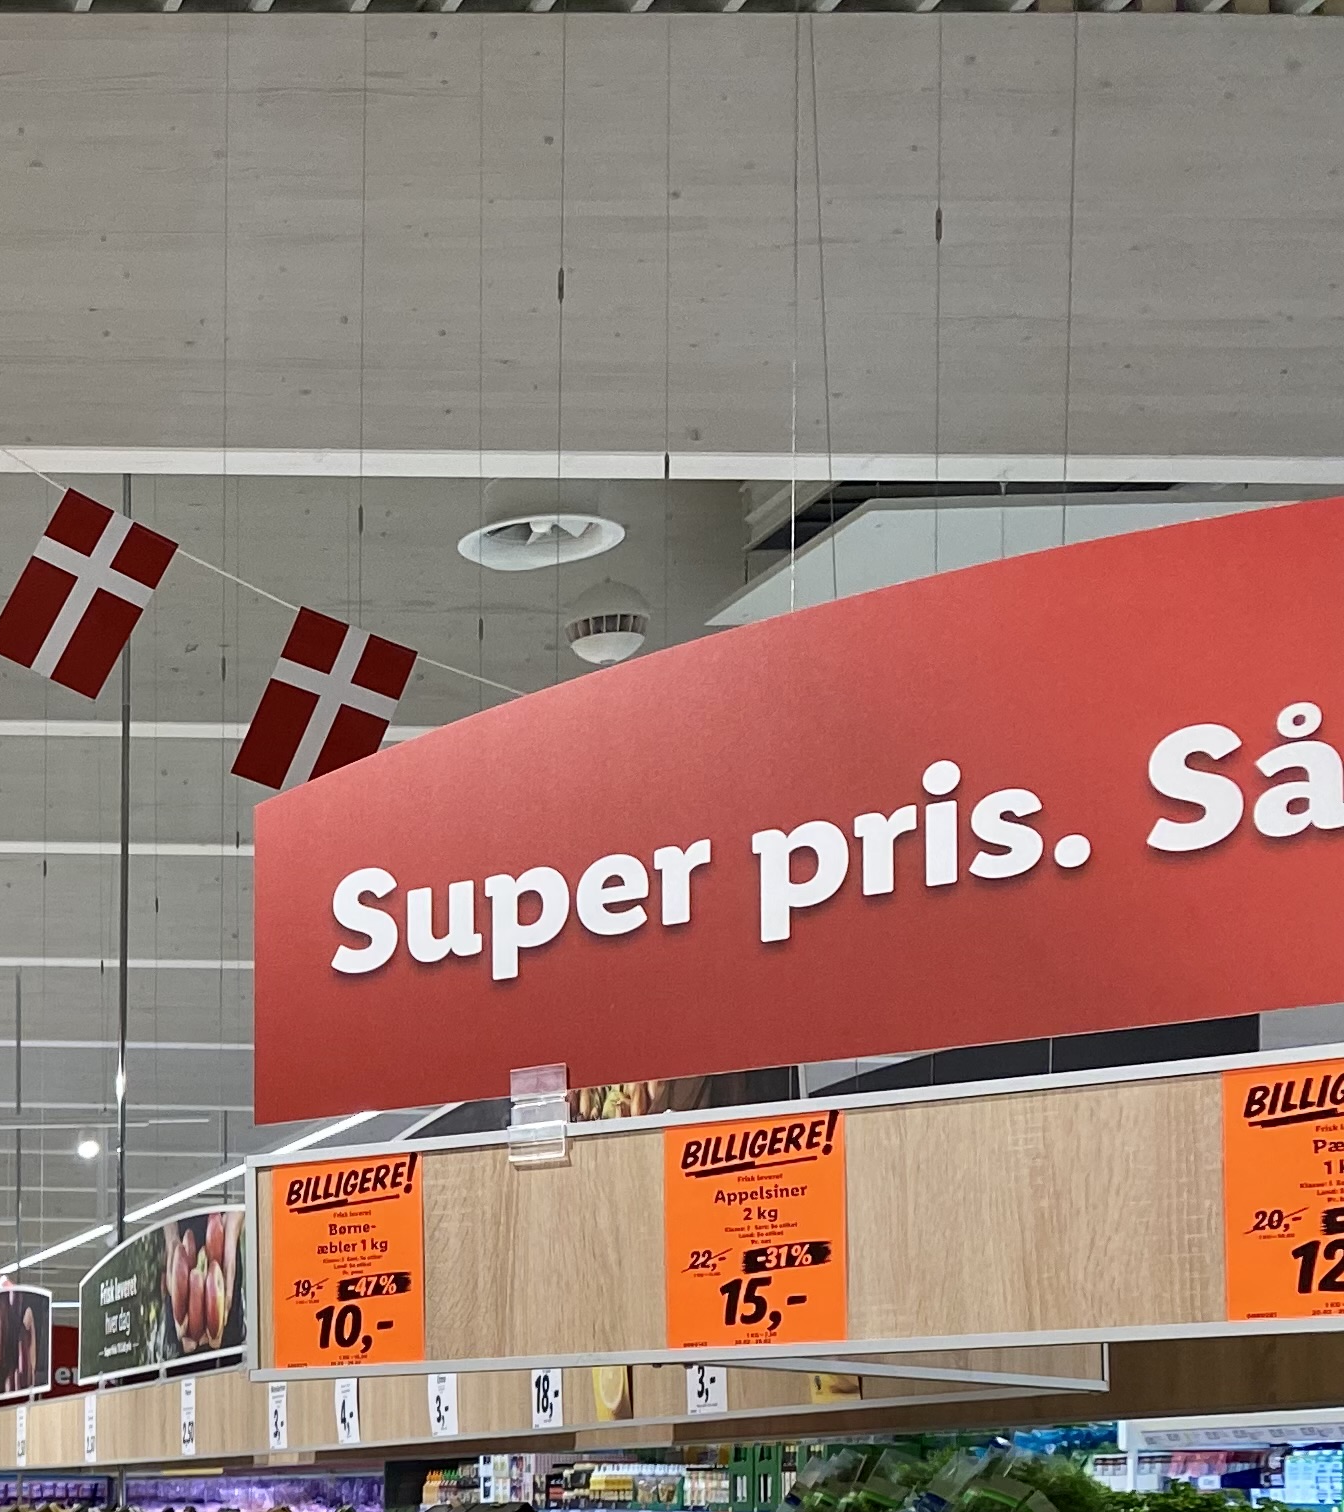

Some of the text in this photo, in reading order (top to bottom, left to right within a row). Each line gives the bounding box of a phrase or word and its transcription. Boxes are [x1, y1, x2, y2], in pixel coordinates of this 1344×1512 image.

[331, 702, 1344, 980] Super pris. Så
[681, 1110, 839, 1169] BILLIGERE!
[286, 1152, 418, 1206] BILLIGERE!
[714, 1184, 807, 1206] Appelsiner
[328, 1223, 376, 1236] Børne-
[743, 1206, 778, 1222] 2 kg
[1253, 1210, 1302, 1232] 20,-
[317, 1238, 388, 1255] æbler 1 kg
[756, 1244, 813, 1268] -31%
[719, 1276, 807, 1331] 15,-
[316, 1304, 394, 1353] 10,-
[535, 1375, 559, 1418] 18,-
